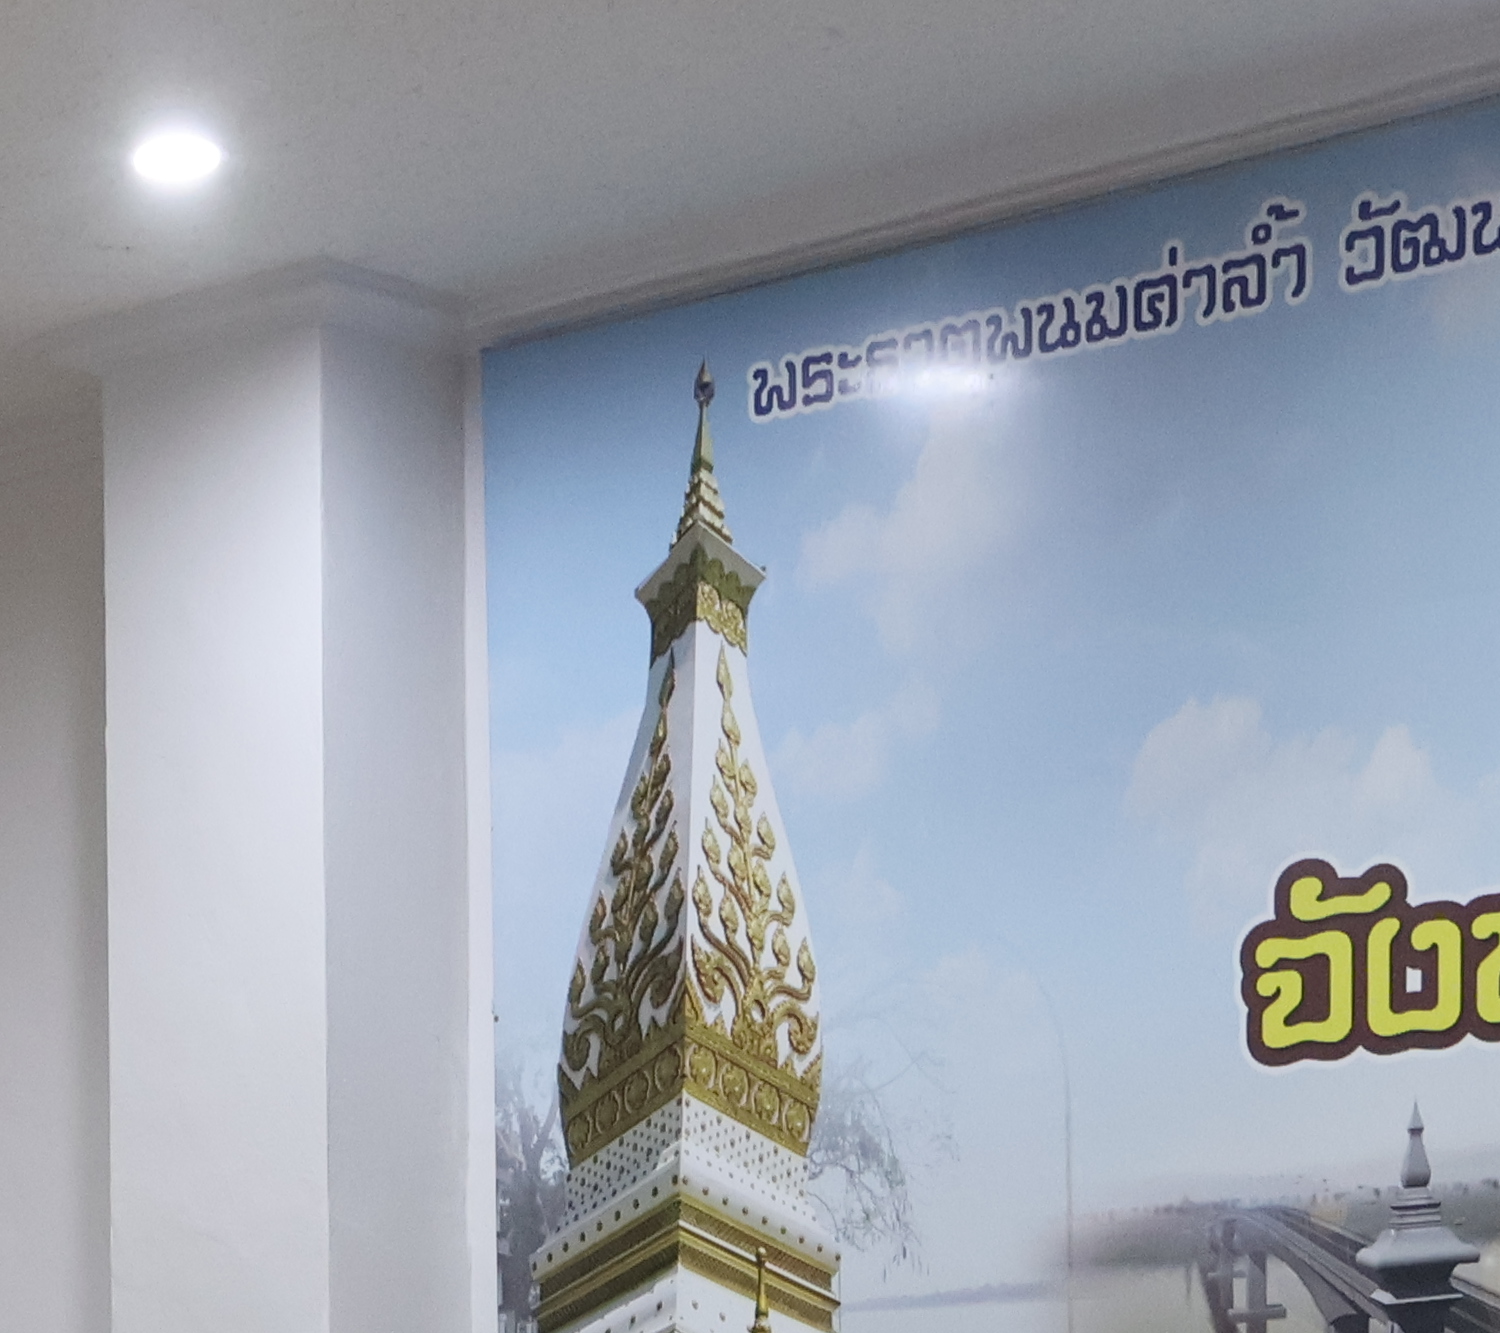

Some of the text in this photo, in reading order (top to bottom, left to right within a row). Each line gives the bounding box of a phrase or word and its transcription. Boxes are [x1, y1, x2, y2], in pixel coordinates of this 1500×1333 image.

[753, 205, 1305, 416] พระธาตพนมค่าล้ำ
